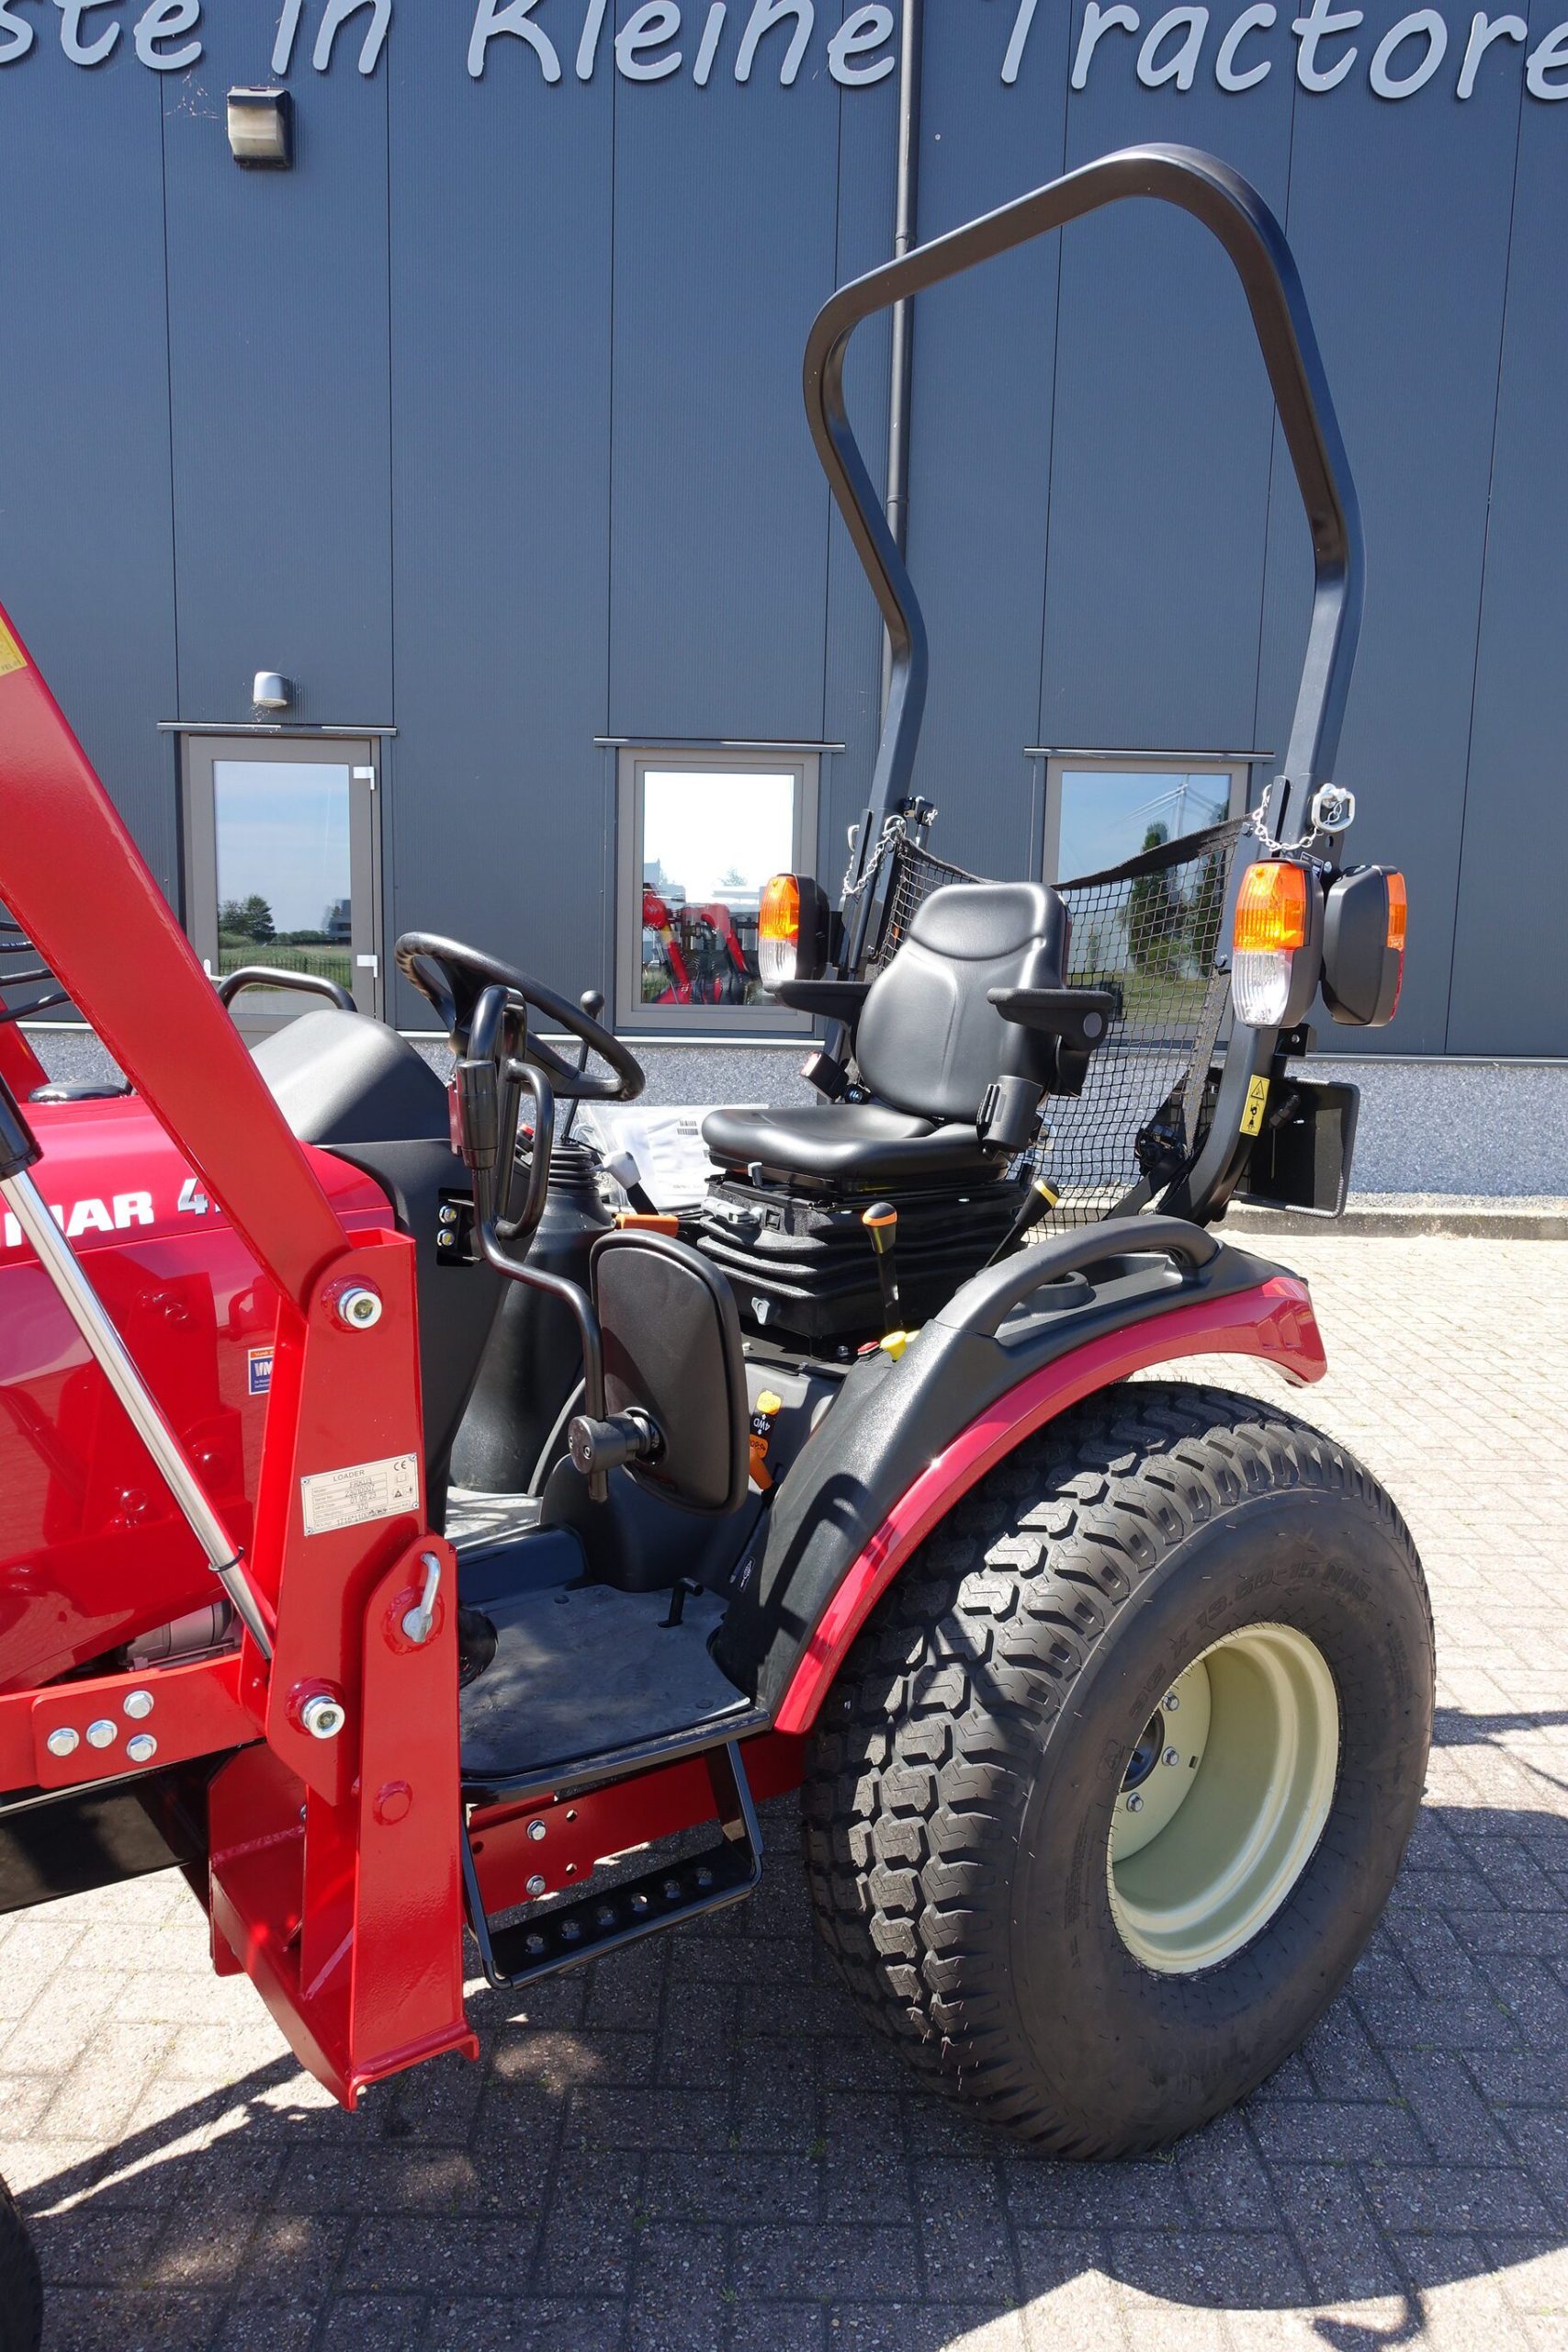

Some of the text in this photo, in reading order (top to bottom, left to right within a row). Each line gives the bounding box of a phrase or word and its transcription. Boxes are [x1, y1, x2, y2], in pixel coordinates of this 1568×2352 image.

[467, 0, 895, 86] Kleine
[753, 1417, 771, 1431] 4WD
[333, 1469, 366, 1482] LOADER
[1322, 1561, 1372, 1602] NHS
